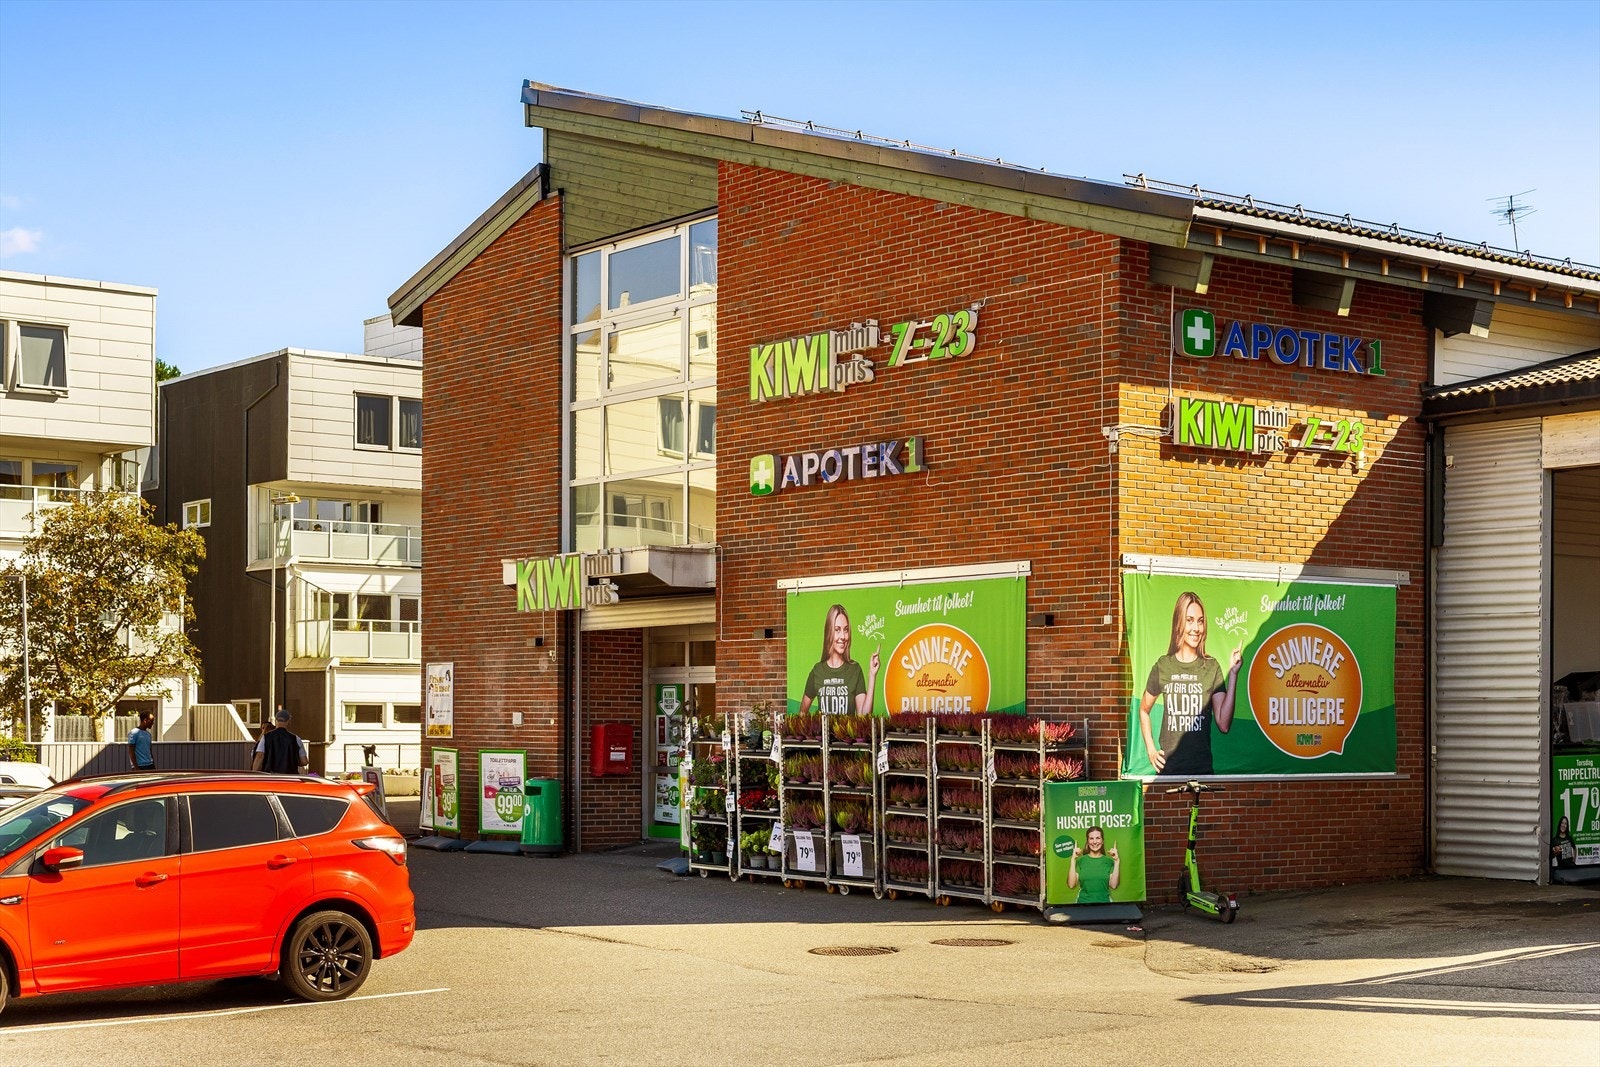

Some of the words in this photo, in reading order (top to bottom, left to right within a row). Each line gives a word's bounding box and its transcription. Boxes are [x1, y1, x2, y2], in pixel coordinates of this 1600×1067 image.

[834, 327, 871, 353] mini
[1223, 320, 1364, 374] APOTEK
[1368, 339, 1385, 376] 1
[750, 333, 830, 402] KIWI
[834, 359, 866, 387] pris
[1179, 397, 1255, 451] KIWI
[1257, 405, 1288, 428] mini
[1257, 431, 1285, 454] pris
[780, 440, 901, 489] APOTEK
[903, 435, 922, 474] 1
[584, 554, 614, 576] mini
[516, 555, 581, 611] KIWI
[584, 585, 612, 612] pris
[894, 597, 932, 617] Sunnhet
[932, 594, 943, 612] til
[943, 590, 975, 617] folket!
[1260, 594, 1302, 613] Sunnhet
[1302, 594, 1314, 611] til
[1313, 593, 1346, 617] folket!
[901, 636, 973, 680] SUNNERE
[1267, 635, 1345, 679] SUNNERE
[825, 686, 836, 696] GIR
[836, 685, 849, 696] OSS
[916, 672, 959, 688] alternativ
[1173, 682, 1187, 693] GIR
[1188, 682, 1203, 694] OSS
[1285, 673, 1331, 689] alternativ
[820, 696, 849, 715] ALDRI
[1167, 693, 1203, 716] ALDRI
[1268, 697, 1345, 725] BILLIGERE
[1074, 800, 1097, 814] HAR
[1098, 799, 1113, 813] DU
[1056, 815, 1097, 830] HUSKET
[1099, 814, 1132, 829] POSE?
